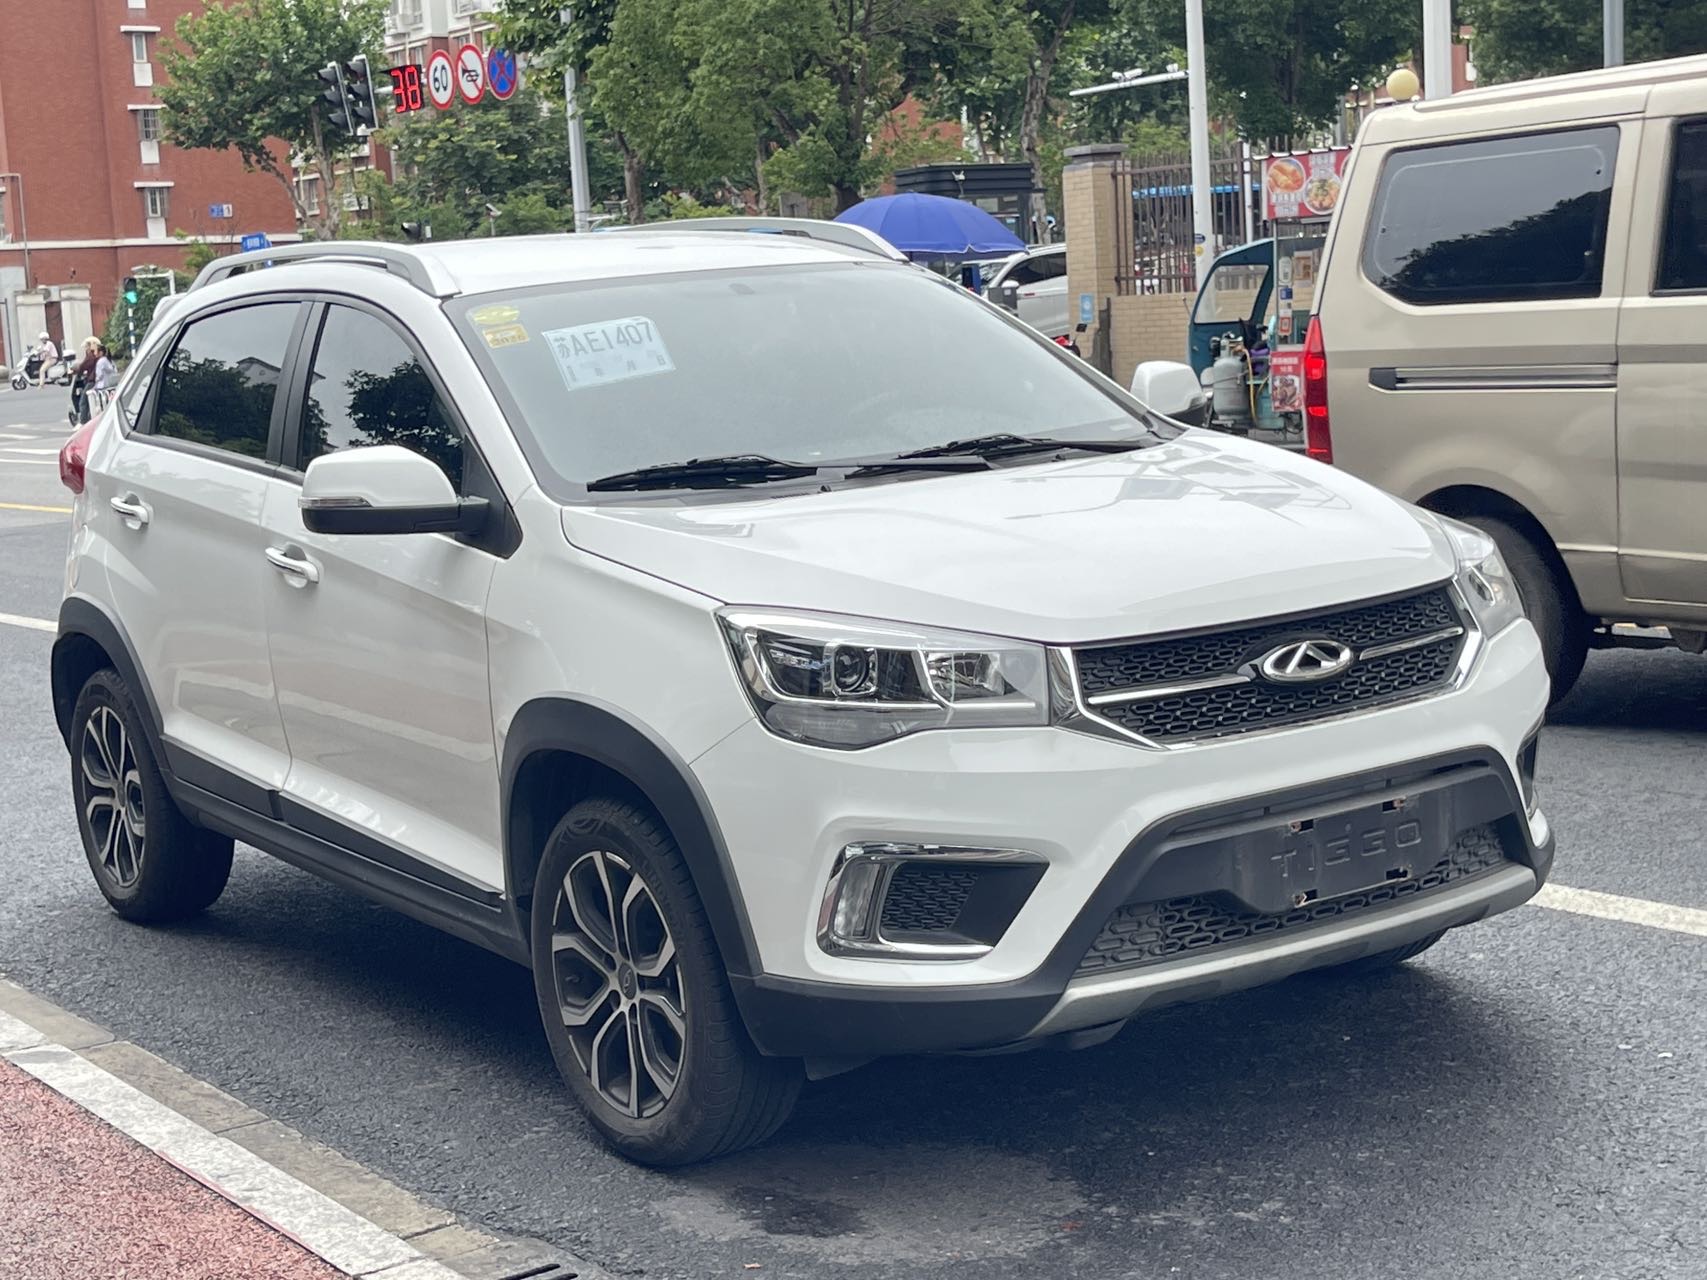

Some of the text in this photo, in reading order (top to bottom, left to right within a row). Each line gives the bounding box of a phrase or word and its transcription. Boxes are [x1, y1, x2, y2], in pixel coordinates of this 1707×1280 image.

[391, 67, 420, 112] 38
[433, 64, 449, 93] 60
[553, 322, 653, 360] 苏AE1407
[1271, 820, 1422, 877] TIGGO
